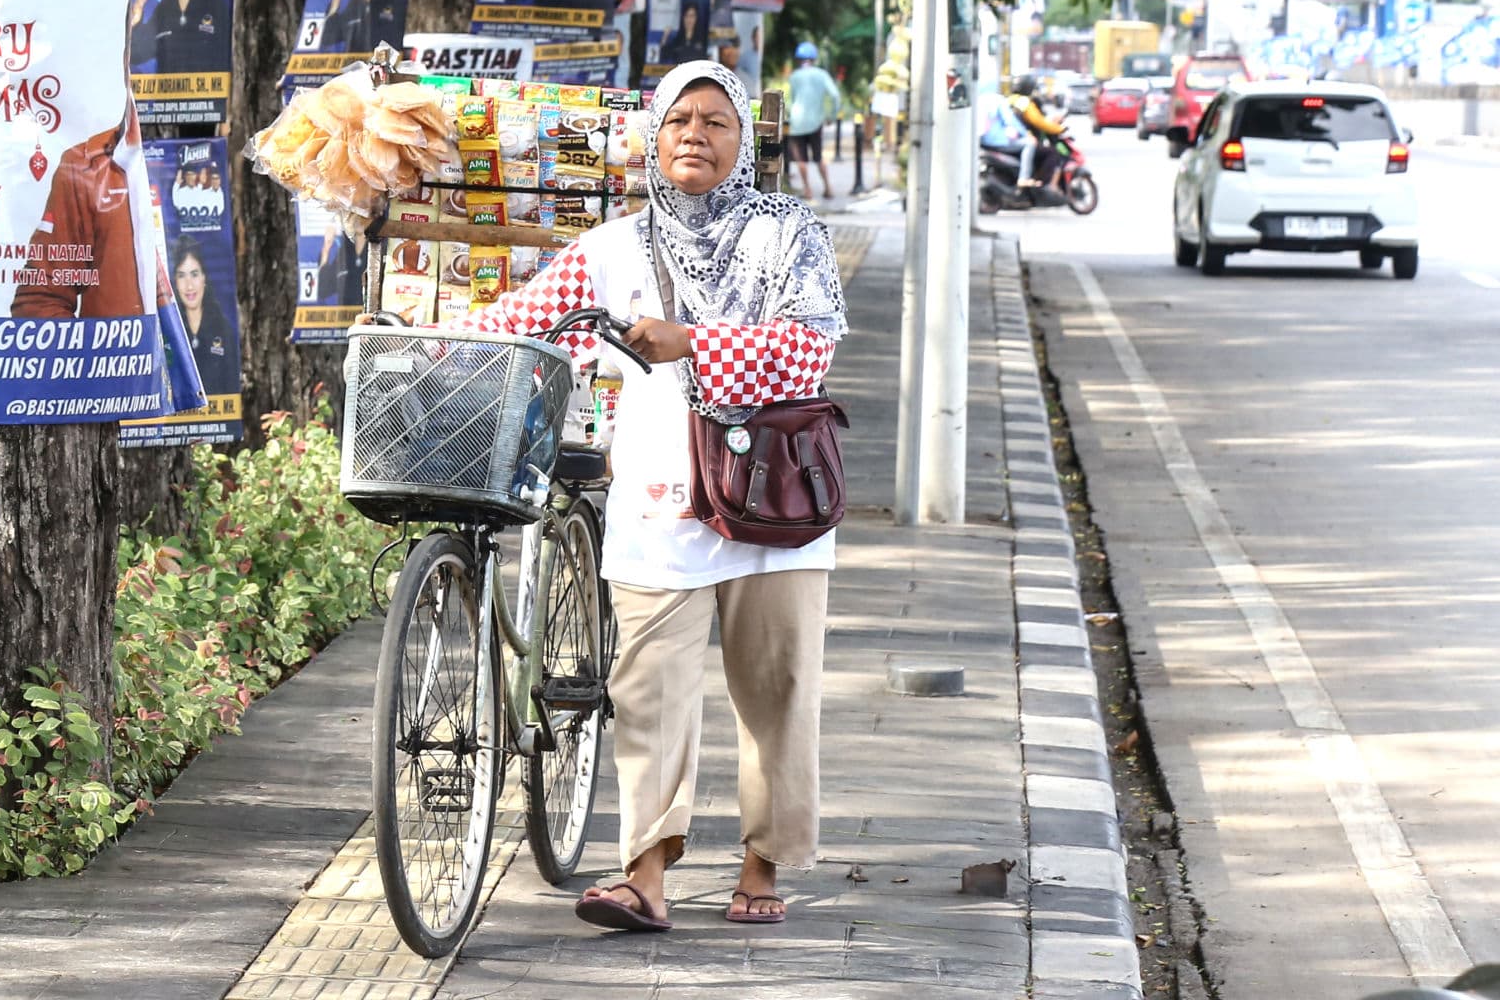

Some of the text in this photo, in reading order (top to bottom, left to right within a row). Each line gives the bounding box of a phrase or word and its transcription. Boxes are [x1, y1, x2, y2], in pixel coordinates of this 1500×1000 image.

[305, 22, 317, 45] 3
[421, 48, 522, 70] BASTIAN
[559, 151, 600, 167] ABC
[557, 214, 599, 228] ABC
[48, 244, 93, 262] NATAL
[12, 268, 46, 286] KITA
[52, 269, 100, 286] SEMUA
[305, 272, 314, 298] 3
[92, 318, 143, 349] DPRD
[51, 356, 84, 380] DKI
[87, 354, 153, 378] JAKARTA
[6, 393, 161, 416] @BASTIANPSIMANJUNTAK
[672, 484, 685, 504] 5
